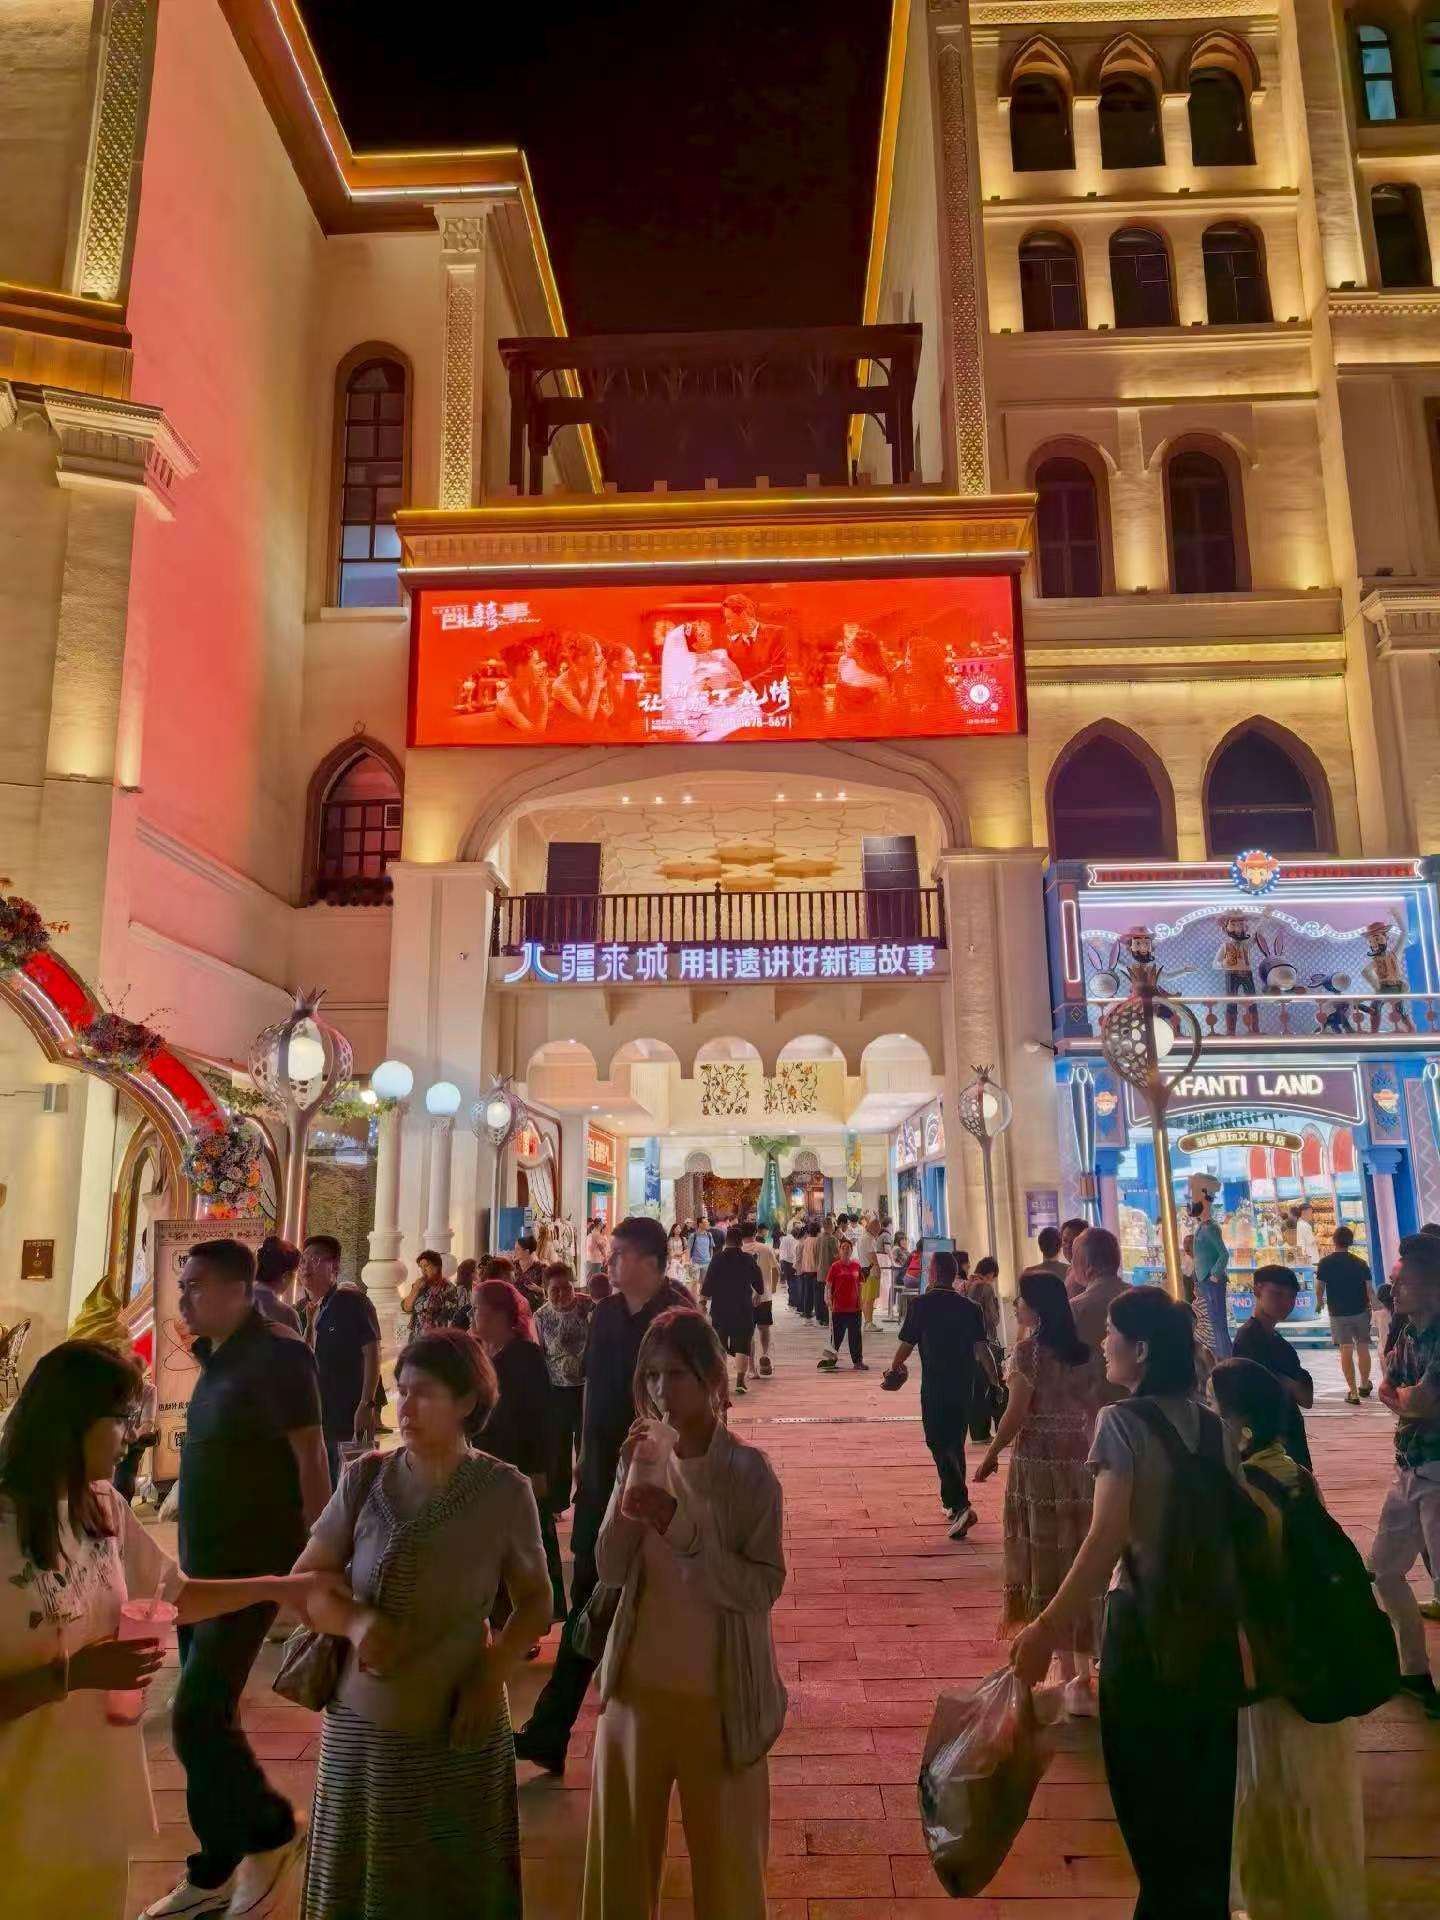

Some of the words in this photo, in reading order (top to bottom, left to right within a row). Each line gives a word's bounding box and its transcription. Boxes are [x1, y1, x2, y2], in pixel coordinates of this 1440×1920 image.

[679, 944, 936, 979] 用非遗讲好新疆故事
[1258, 1074, 1324, 1096] LAND
